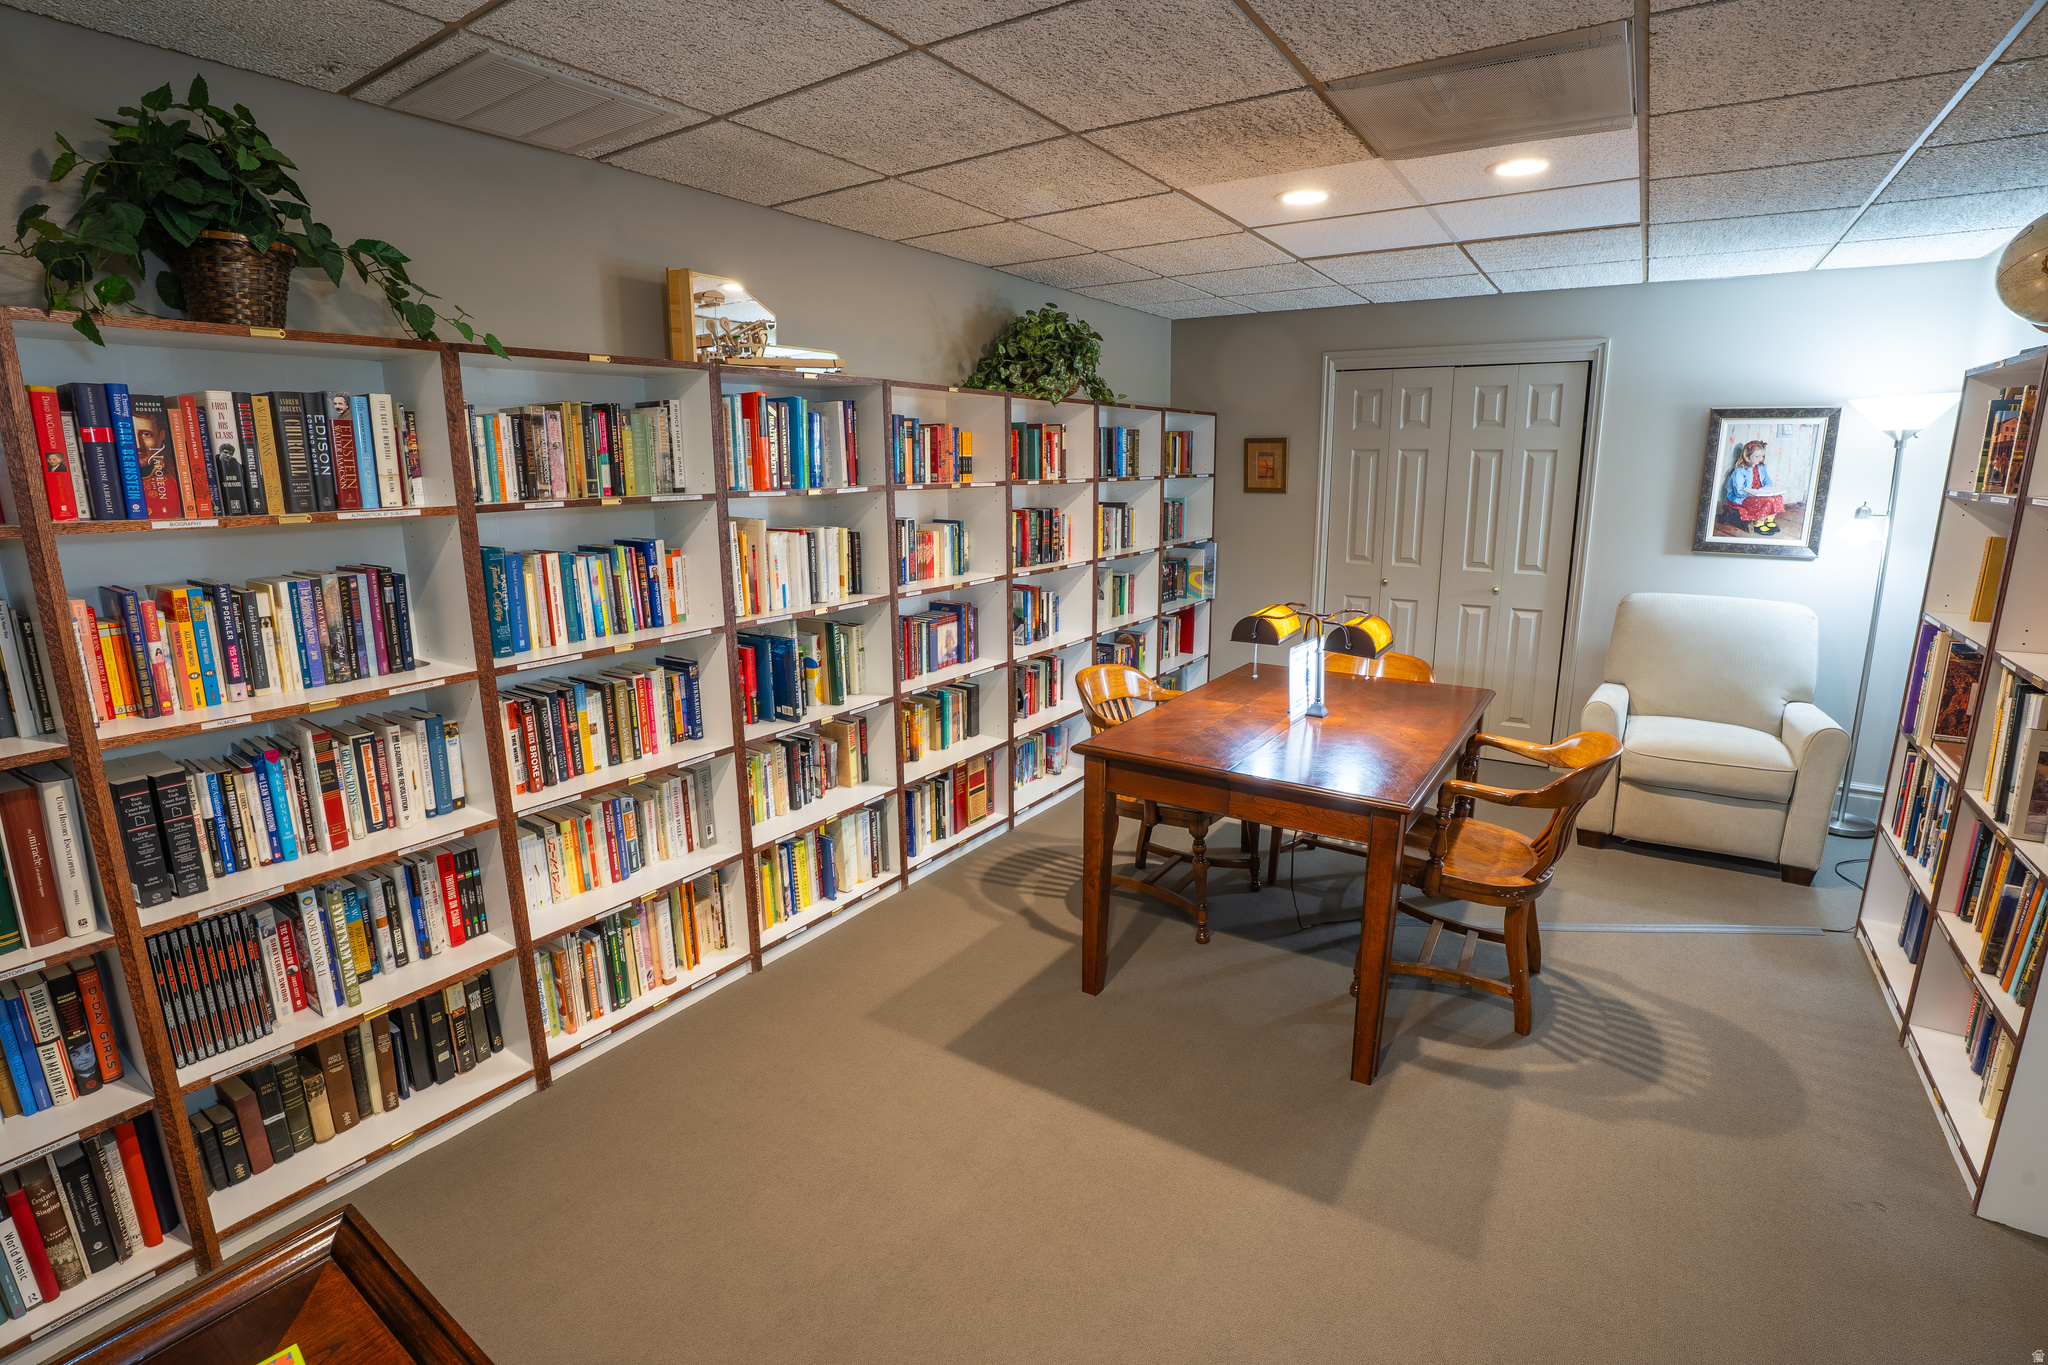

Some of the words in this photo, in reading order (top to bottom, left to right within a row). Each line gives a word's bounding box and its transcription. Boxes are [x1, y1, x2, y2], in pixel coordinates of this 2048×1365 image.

[113, 393, 122, 417] History
[121, 393, 130, 417] Chasing
[211, 402, 228, 410] FIRST
[218, 412, 225, 420] IN
[238, 403, 254, 439] DISLOYAL
[256, 406, 266, 430] WILD
[306, 414, 316, 445] EDMUND
[63, 420, 71, 440] Mitch
[68, 443, 76, 465] Albom
[117, 422, 131, 447] CARL
[215, 431, 234, 439] CLASS
[259, 432, 272, 457] SWANS
[314, 414, 331, 476] EDISON
[334, 425, 342, 452] WALTER
[246, 448, 256, 471] MICHAEL
[283, 419, 308, 477] CHURCHILL
[340, 424, 358, 489] EINSTEIN
[626, 438, 635, 478] ELEANOR
[123, 449, 141, 500] BERNSTEIN
[148, 444, 167, 500] NAPOLEON
[310, 449, 320, 476] MORRIS
[337, 454, 347, 489] ISAACSON
[96, 446, 108, 482] MADELEINE
[102, 483, 114, 514] ALBRIGHT
[249, 472, 260, 488] COHEN
[218, 586, 228, 603] AMY
[338, 579, 351, 614] ARIANA
[399, 594, 407, 614] SHACK
[146, 605, 155, 622] MINDY
[222, 605, 234, 641] POEHLER
[247, 604, 257, 623] david
[314, 586, 322, 600] ONE
[318, 618, 327, 637] YEAR
[149, 621, 158, 641] KALING
[200, 637, 208, 647] THE
[250, 623, 260, 647] sedaris
[183, 630, 191, 640] ALL
[187, 650, 195, 667] WORDS
[202, 648, 211, 665] WORDS
[228, 645, 237, 657] YES
[230, 657, 241, 678] PLEASE
[639, 696, 647, 723] CHANGE
[690, 681, 703, 725] TURNAROUND
[217, 718, 237, 726] HUMOR
[525, 715, 533, 732] GLENN
[527, 732, 535, 745] BECK
[572, 735, 578, 743] AL
[362, 744, 373, 772] Handbook
[392, 743, 403, 768] LEADING
[512, 747, 520, 763] WIRE
[529, 745, 540, 778] BROKE
[573, 744, 582, 770] FRANKEN
[209, 778, 219, 791] The
[367, 772, 374, 780] of
[396, 767, 404, 779] THE
[259, 781, 269, 797] LEAN
[273, 766, 283, 792] MAKE
[279, 796, 290, 829] MONEY
[368, 779, 378, 803] Business
[398, 778, 409, 812] REVOLUTION
[55, 795, 64, 812] UTAH
[210, 790, 224, 818] Anatomy
[262, 796, 276, 832] TURNAROUND
[372, 804, 381, 822] Letters
[59, 813, 69, 837] HISTORY
[218, 823, 228, 841] Peace
[28, 834, 42, 867] miracle
[63, 838, 76, 878] ENCYCLOPEDIA
[347, 891, 357, 907] IAN
[445, 874, 456, 900] THRIVING
[213, 901, 239, 912] BUSINESS
[240, 891, 270, 904] REFERENCE
[372, 885, 386, 918] LEADING
[449, 900, 457, 909] ON
[305, 910, 321, 946] WORLD
[450, 909, 461, 928] CHAOS
[332, 908, 353, 961] VIETNAM
[354, 927, 367, 956] PACIFIC
[313, 946, 325, 969] WAR
[270, 938, 283, 977] SHATTERED
[278, 978, 288, 1003] SWORD
[317, 969, 327, 977] II
[342, 959, 358, 987] WAR
[31, 989, 47, 1016] DOUBLE
[39, 1016, 54, 1038] CROSS
[87, 986, 106, 1027] D-DAY
[99, 1030, 116, 1070] GIRLS
[455, 1021, 465, 1046] BIBLE
[43, 1047, 55, 1061] BEN
[48, 1061, 66, 1099] MACINTYRE
[260, 1081, 275, 1090] HOLY
[14, 1152, 39, 1166] WORLD
[40, 1146, 54, 1155] WAR
[31, 1190, 56, 1206] Century
[35, 1202, 61, 1216] Singing
[78, 1173, 98, 1204] READING
[88, 1202, 104, 1226] LYRICS
[3, 1231, 22, 1258] World
[13, 1257, 30, 1281] Music
[50, 1310, 80, 1329] MORMON
[81, 1292, 120, 1312] TABERNACLE
[121, 1280, 139, 1293] CHOIR
